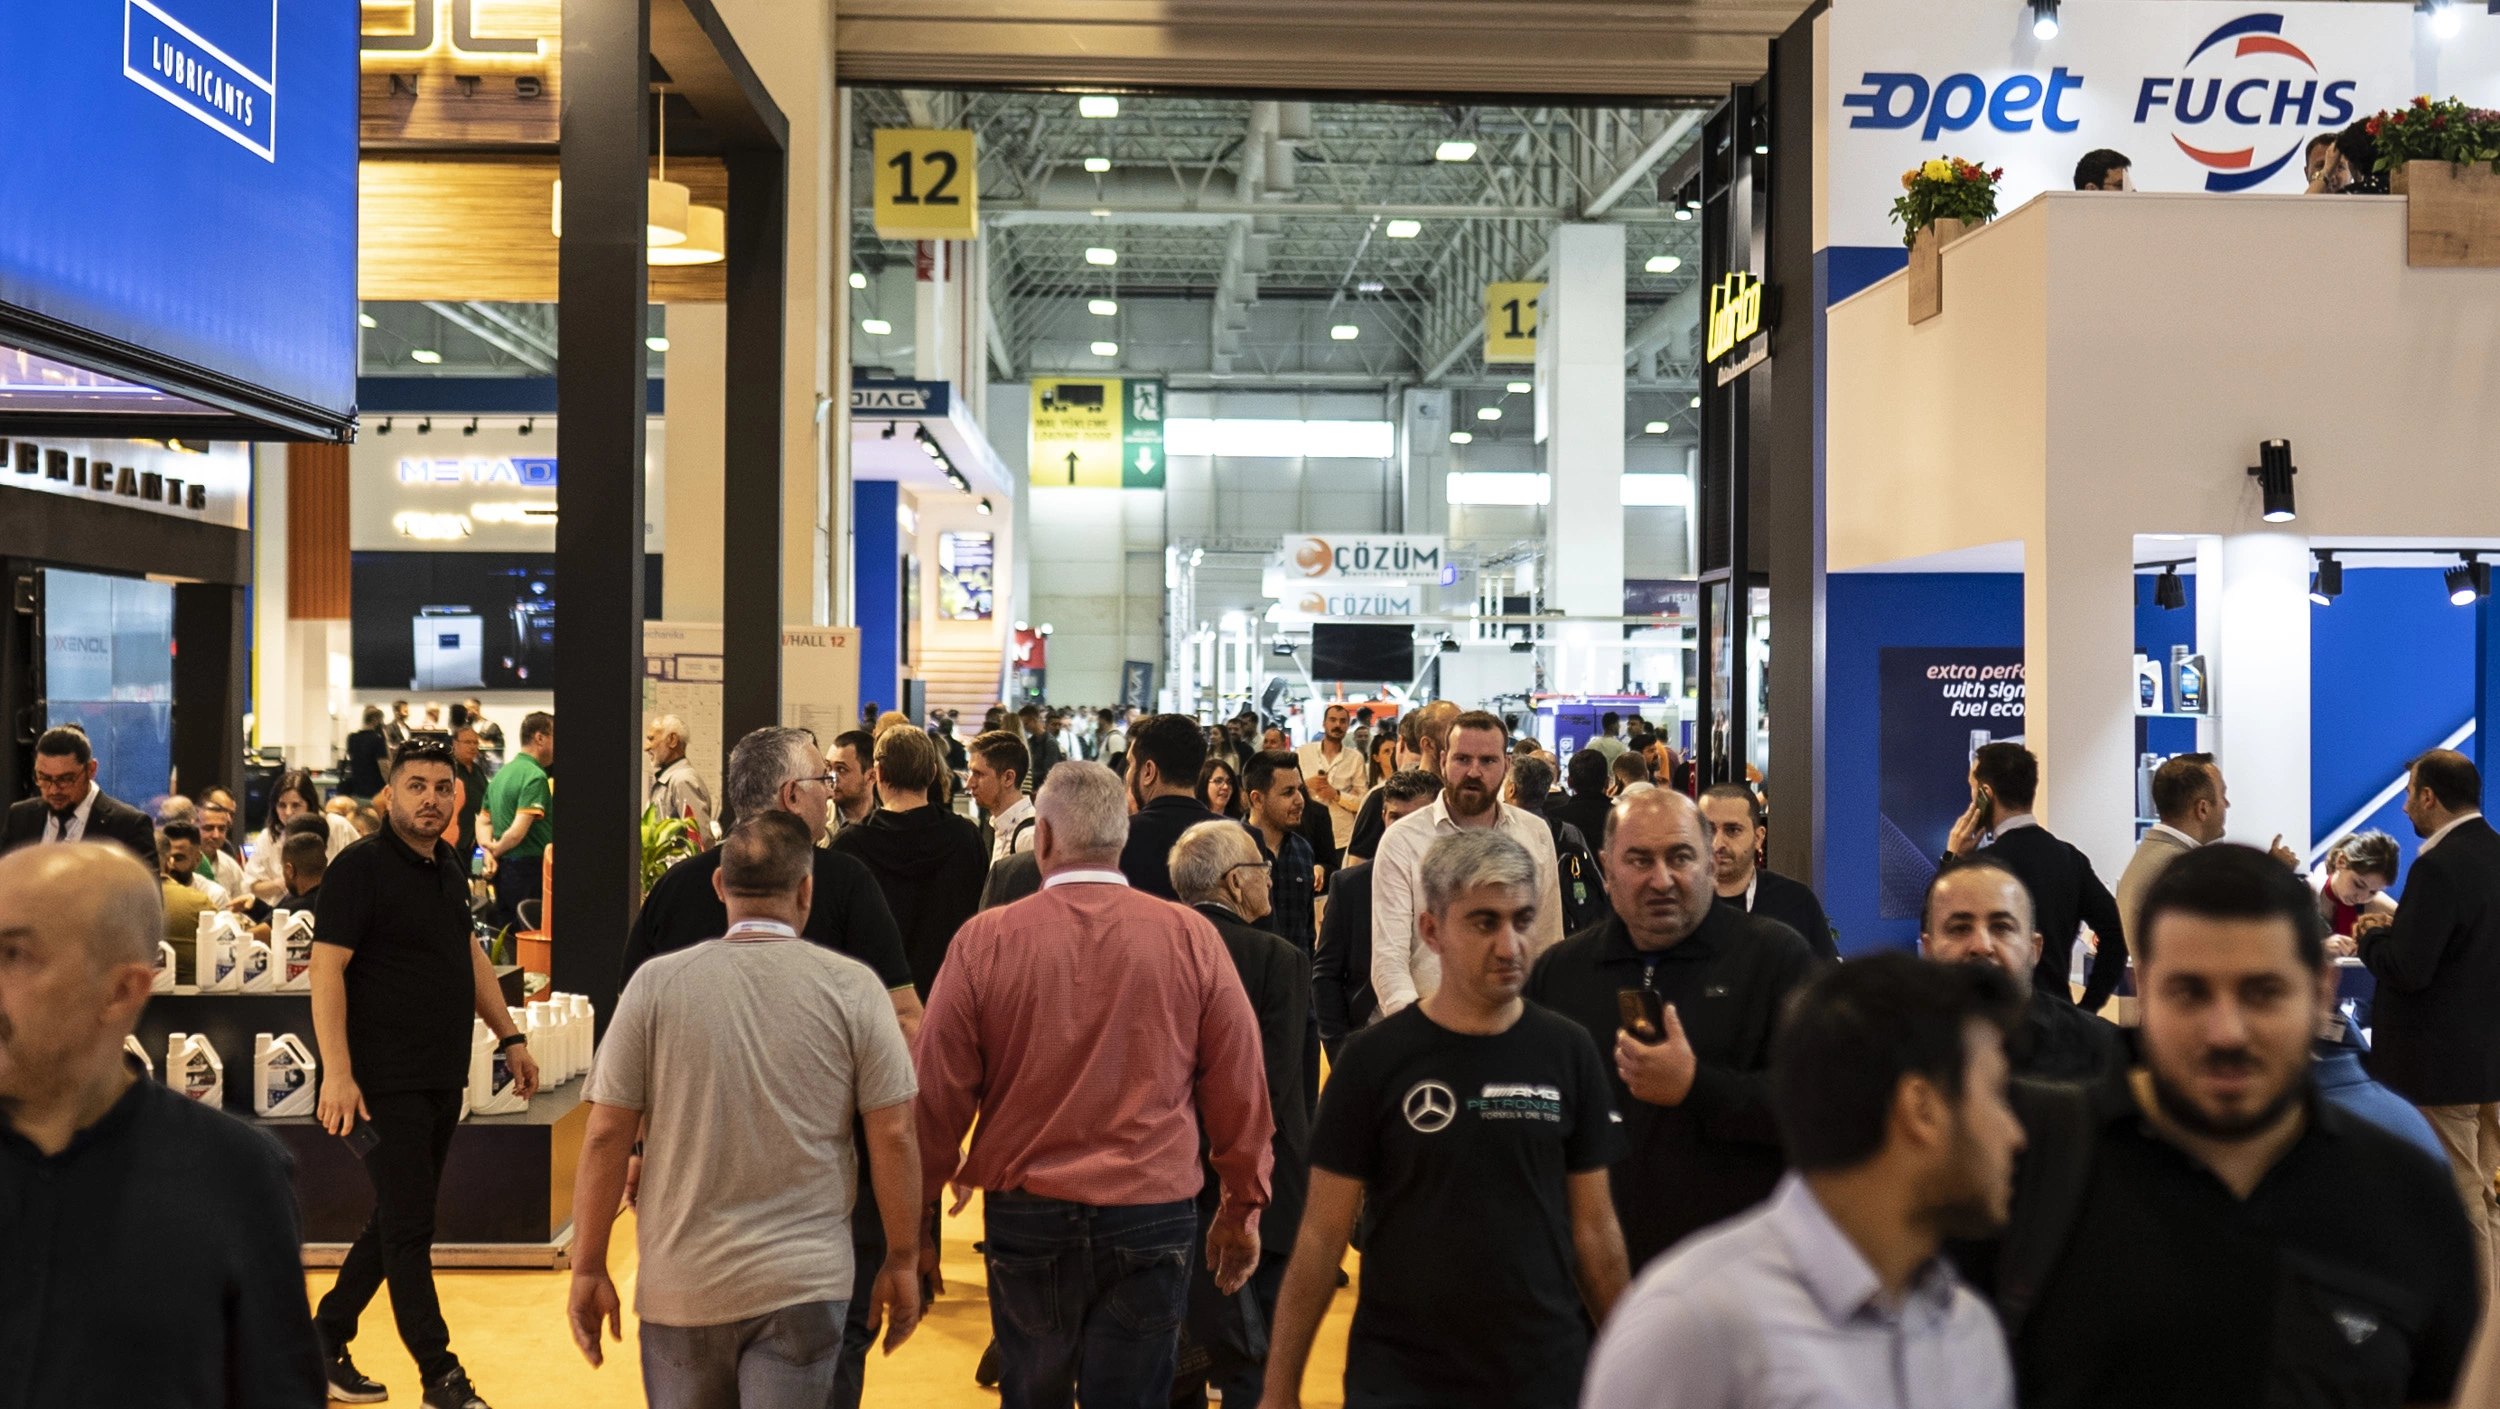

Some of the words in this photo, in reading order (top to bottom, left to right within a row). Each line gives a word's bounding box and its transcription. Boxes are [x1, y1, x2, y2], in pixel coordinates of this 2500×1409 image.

[153, 36, 253, 127] LUBRICANTS
[1843, 66, 2084, 141] opet
[2133, 77, 2357, 126] FUCHS
[888, 151, 960, 205] 12
[1334, 541, 1439, 577] ÇÖZÜM
[830, 635, 846, 648] 12
[1926, 663, 1977, 679] extra
[1943, 681, 1986, 698] with
[1950, 700, 1988, 717] fuel
[1511, 1086, 1561, 1100] AMG
[1467, 1099, 1561, 1113] PETRONAS
